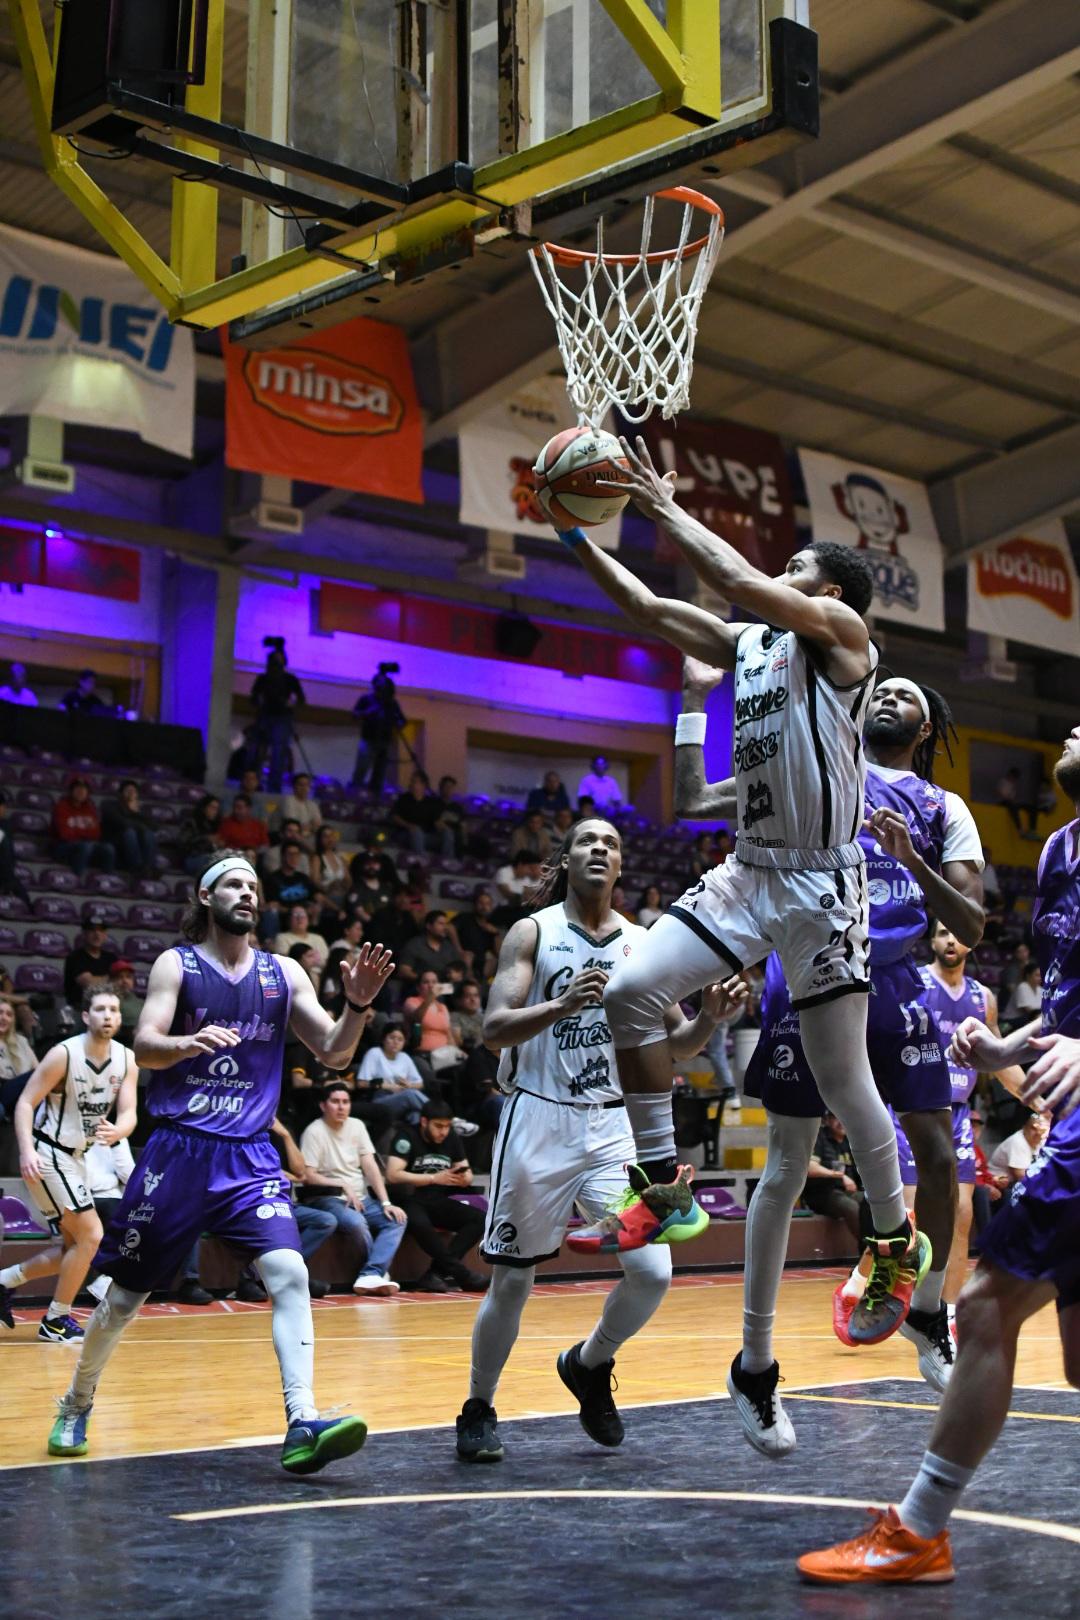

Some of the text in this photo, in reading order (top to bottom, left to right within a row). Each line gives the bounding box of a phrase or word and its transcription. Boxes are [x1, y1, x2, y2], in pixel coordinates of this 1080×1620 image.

[185, 1074, 219, 1087] Banco
[767, 1066, 800, 1082] MEGA
[211, 1095, 244, 1113] UAD
[488, 1241, 521, 1256] MEGA
